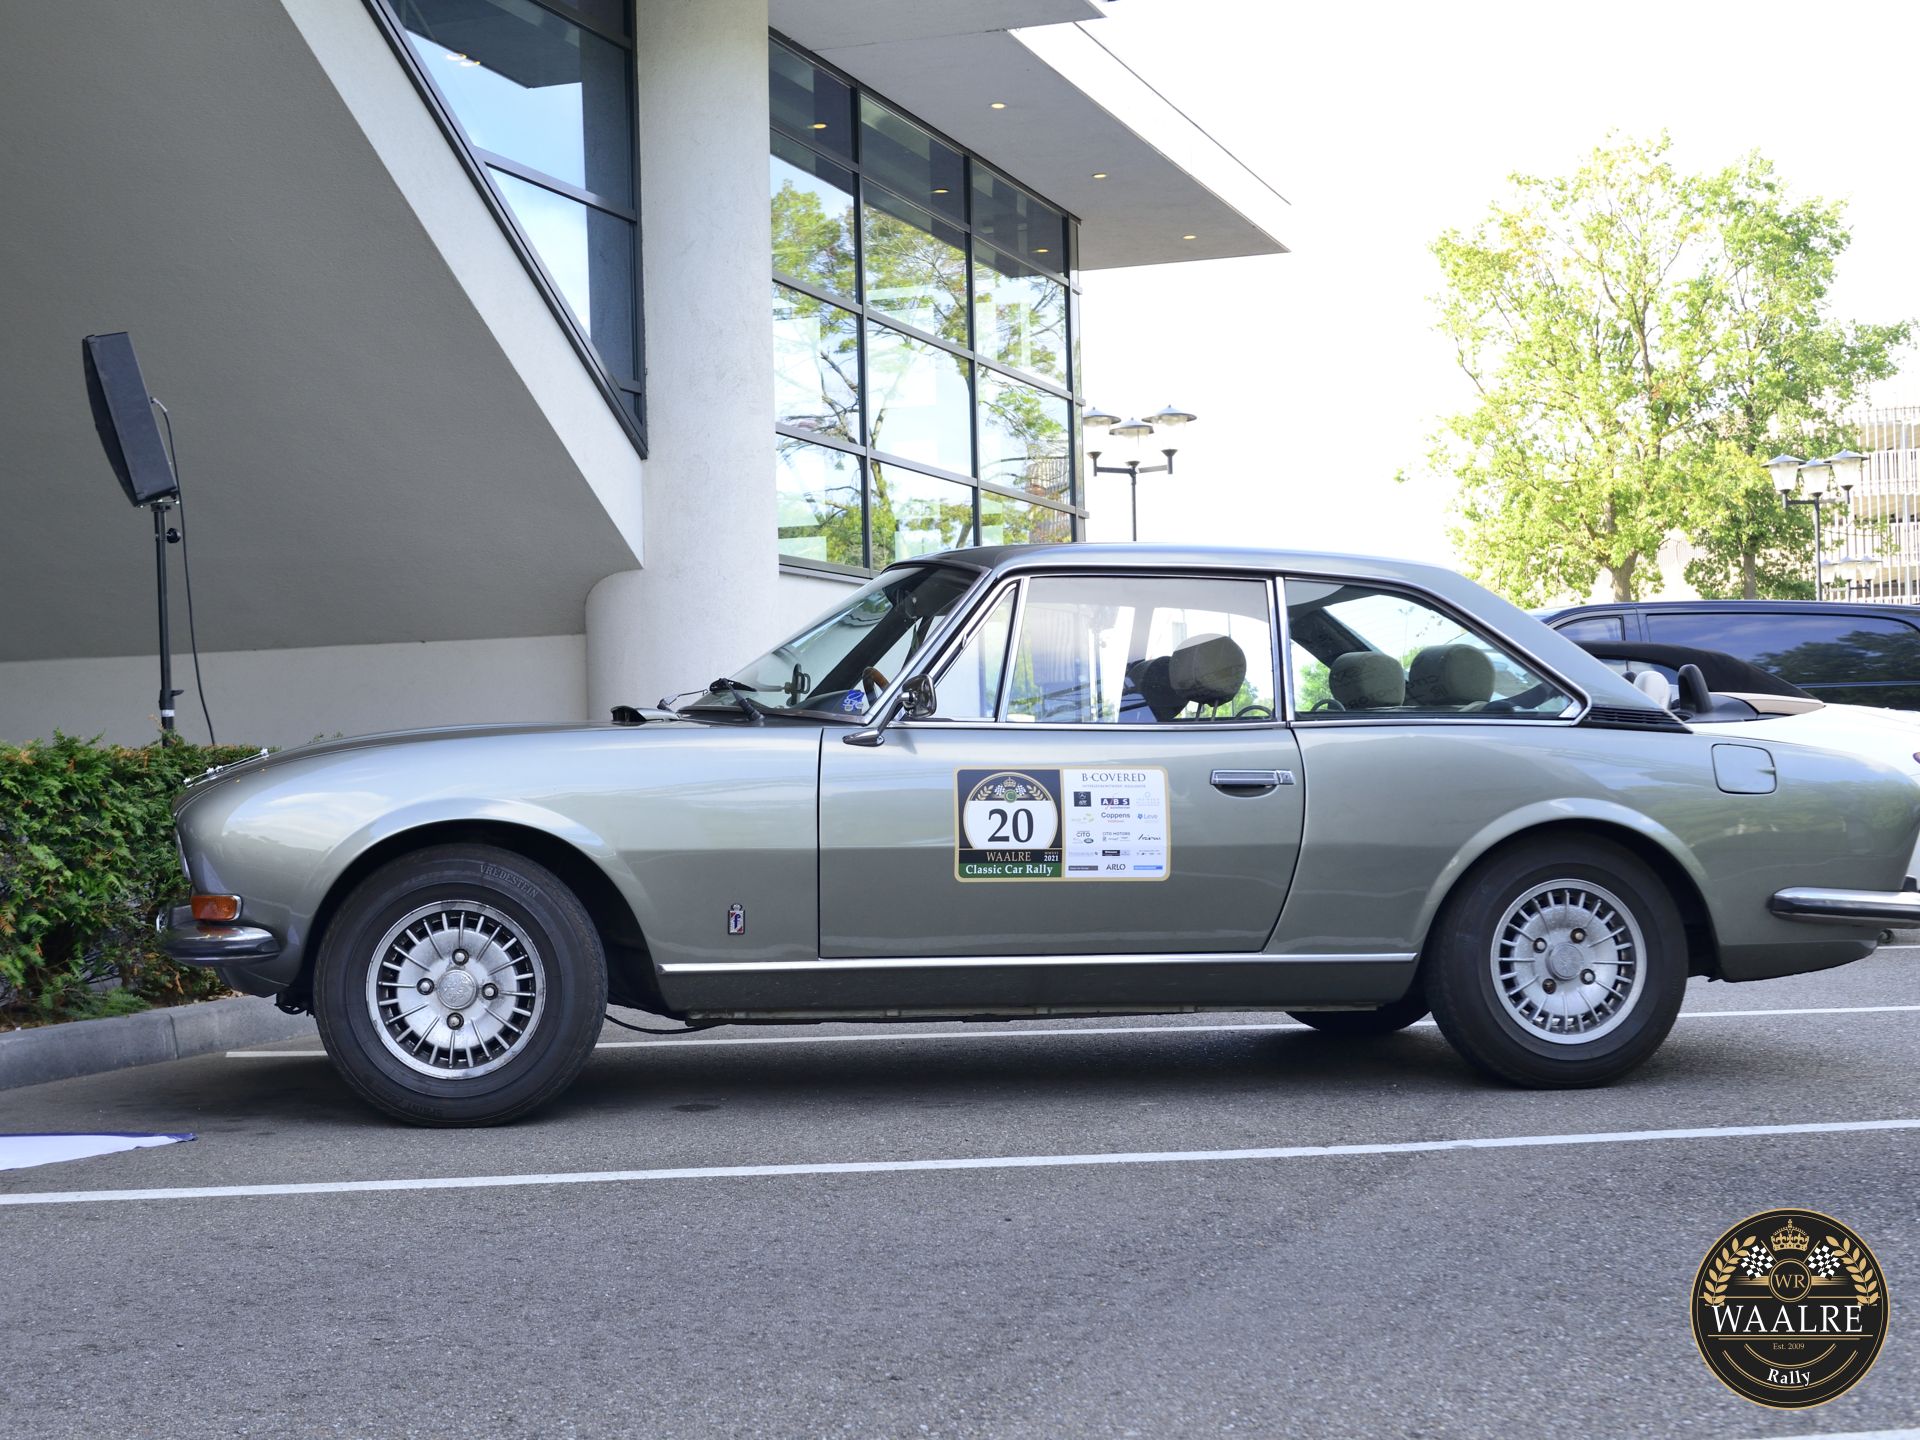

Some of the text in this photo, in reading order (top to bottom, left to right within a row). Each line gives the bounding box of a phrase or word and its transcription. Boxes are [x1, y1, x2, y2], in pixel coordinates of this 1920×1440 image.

[987, 808, 1034, 843] 20
[986, 851, 1031, 862] WAALRE
[965, 864, 1053, 876] Classic Car Rally
[1106, 863, 1126, 871] ARLO
[480, 864, 538, 898] VREDESTEIN
